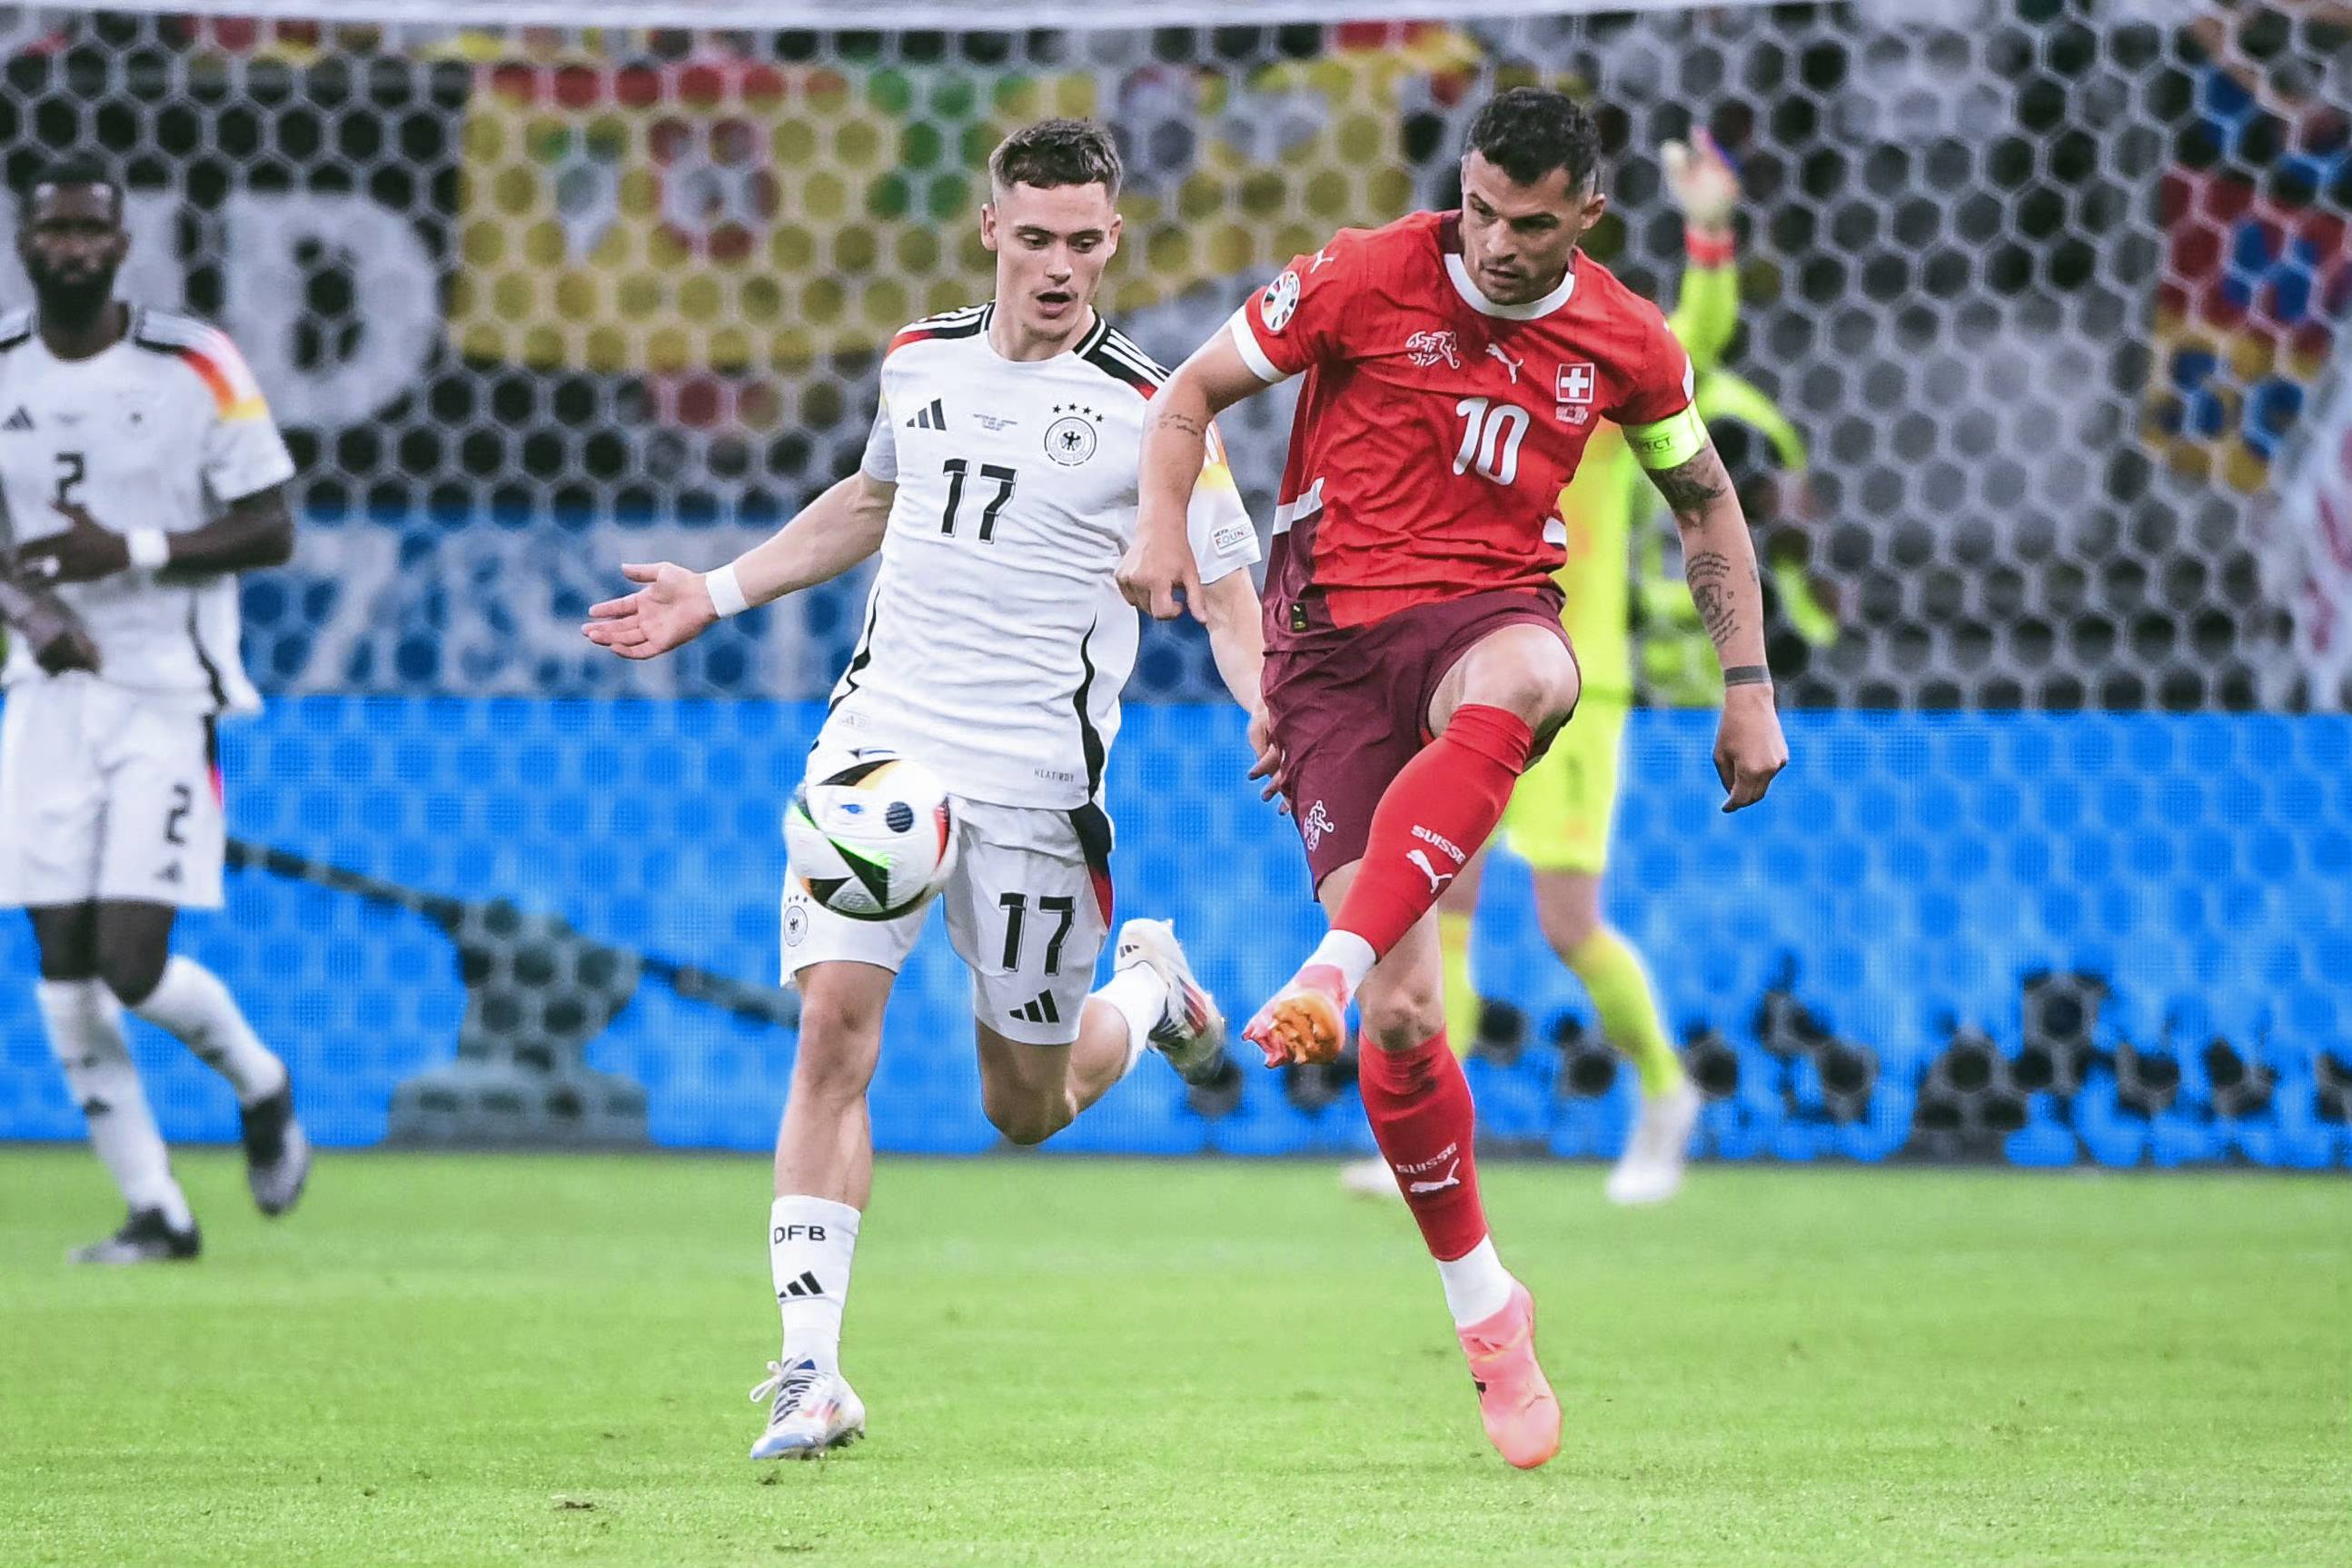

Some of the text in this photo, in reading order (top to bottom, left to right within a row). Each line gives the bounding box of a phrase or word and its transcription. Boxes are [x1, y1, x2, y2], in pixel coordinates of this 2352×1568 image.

[1453, 397, 1530, 485] 10
[56, 452, 84, 511] 2
[941, 458, 1018, 545] 17
[166, 784, 191, 846] 2
[1411, 824, 1466, 865] SUISSE
[998, 892, 1077, 977] 17
[774, 1224, 827, 1245] DFB
